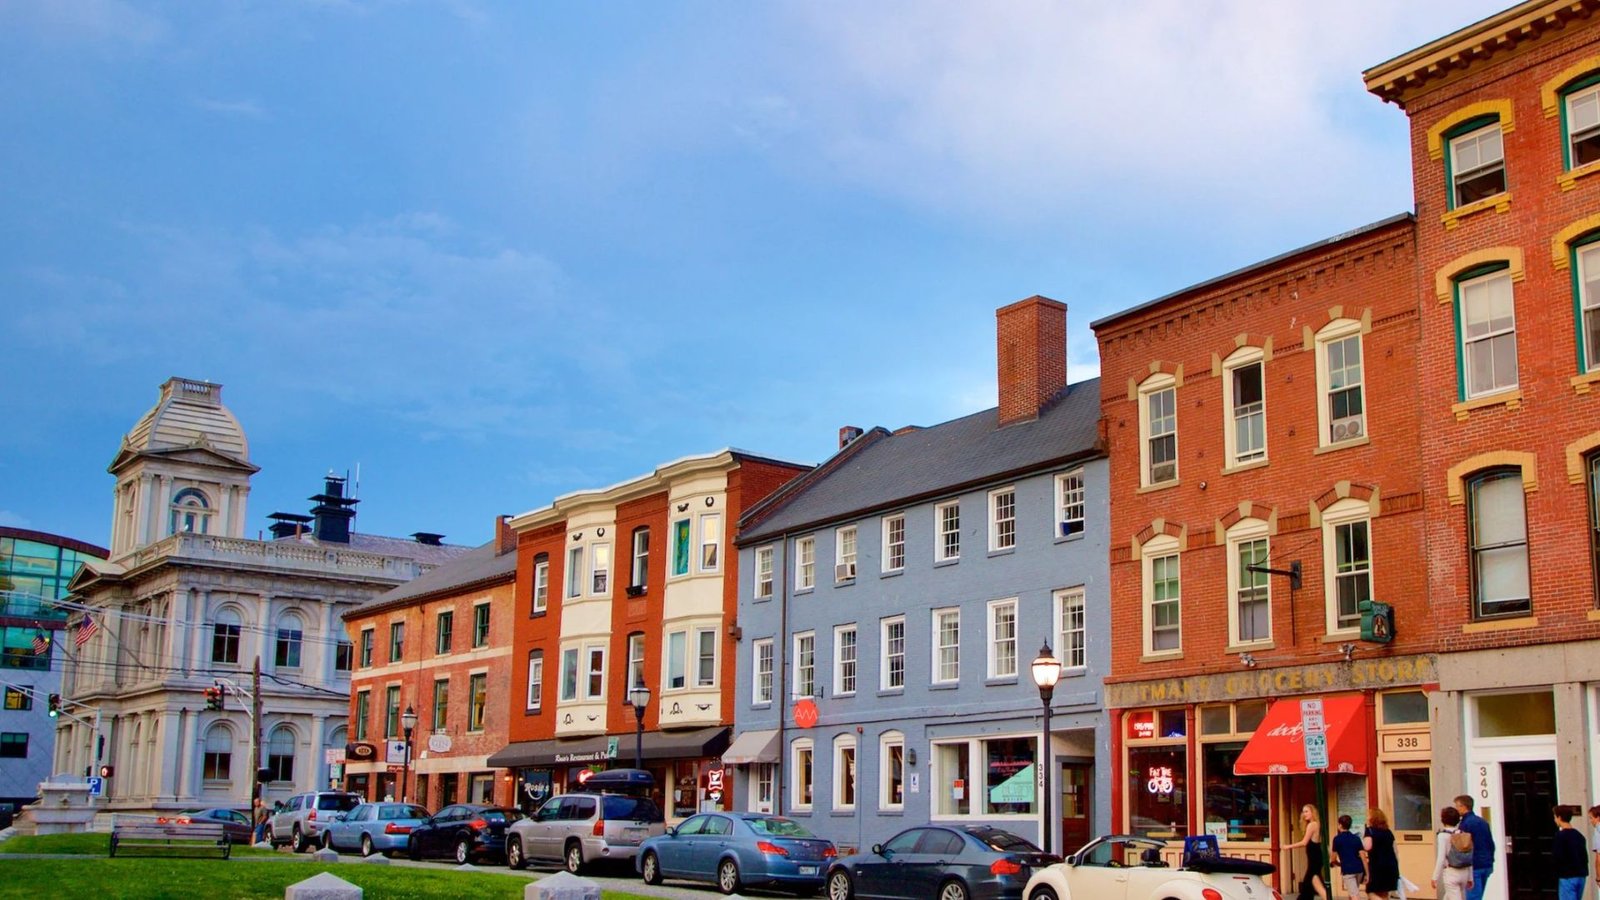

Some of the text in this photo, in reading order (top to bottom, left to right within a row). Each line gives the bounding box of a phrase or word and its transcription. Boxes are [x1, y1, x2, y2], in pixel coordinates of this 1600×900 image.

[1225, 669, 1334, 695] GROCERY
[1397, 737, 1418, 748] 338
[595, 751, 600, 760] &
[1480, 766, 1488, 799] 340
